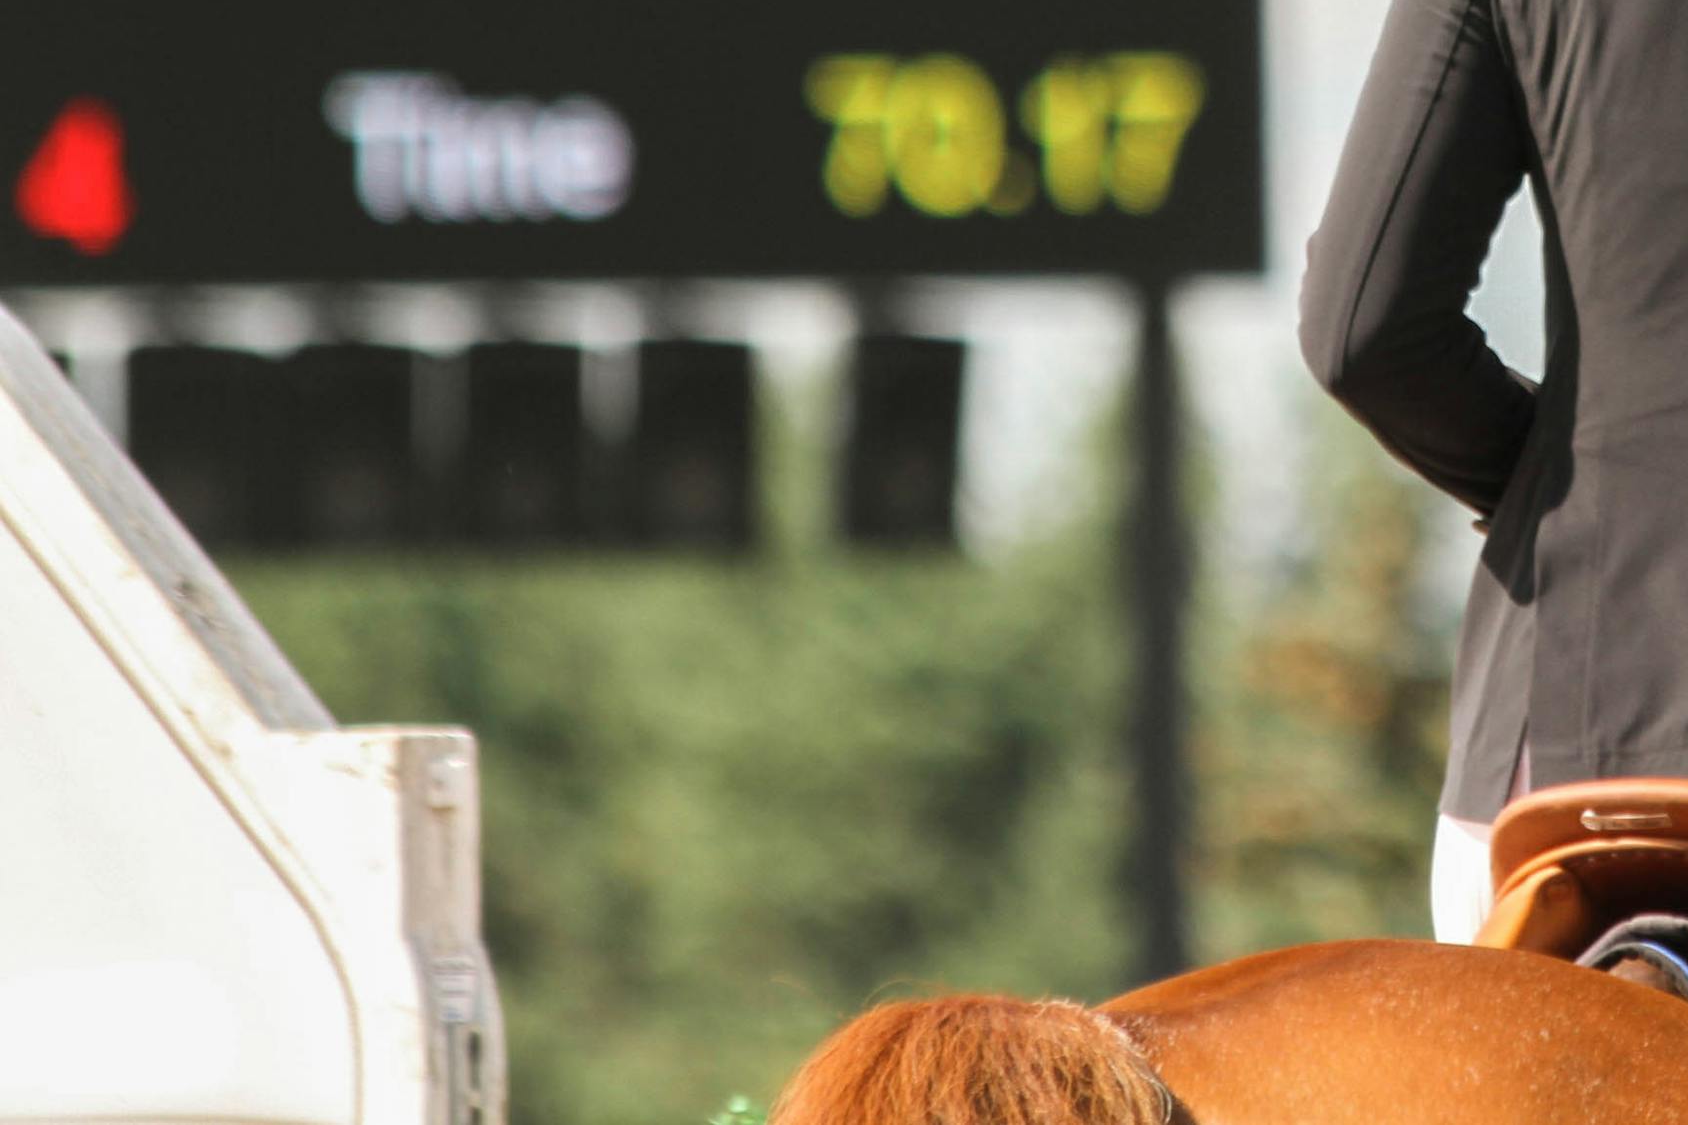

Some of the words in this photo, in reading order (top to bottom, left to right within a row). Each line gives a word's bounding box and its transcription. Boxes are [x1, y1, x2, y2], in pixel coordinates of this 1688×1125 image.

[16, 101, 132, 254] 4
[327, 72, 631, 220] Time
[810, 52, 1201, 216] 70.17
